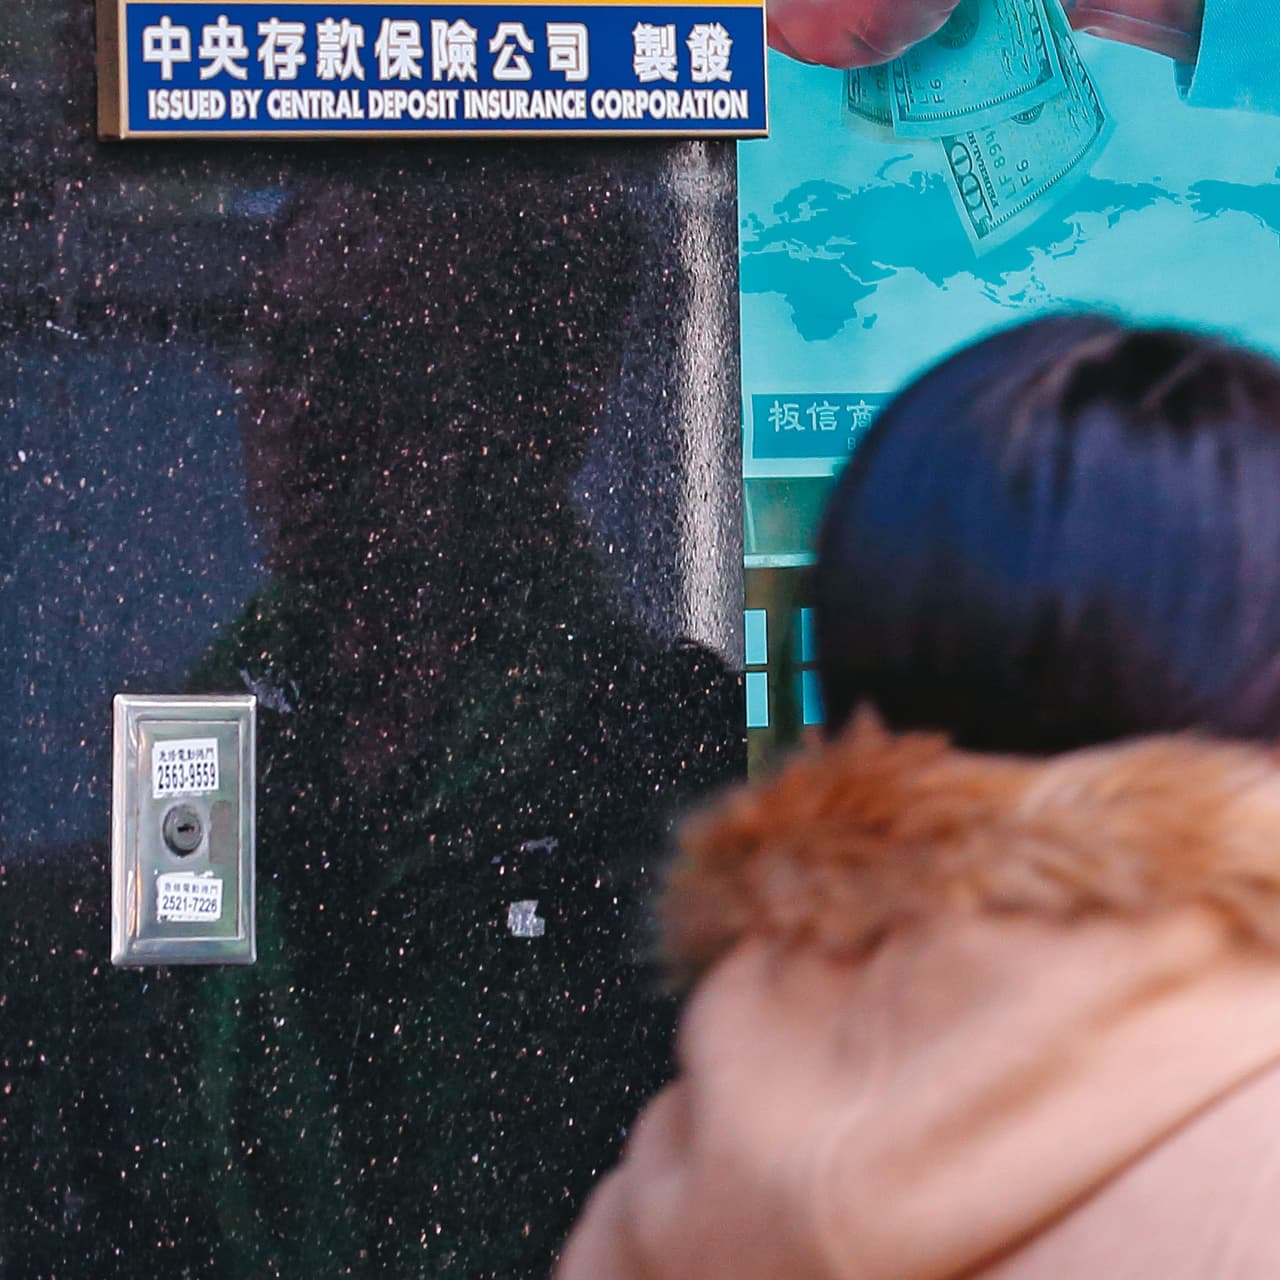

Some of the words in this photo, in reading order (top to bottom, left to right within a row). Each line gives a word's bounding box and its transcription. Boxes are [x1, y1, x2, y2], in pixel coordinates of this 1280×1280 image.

[142, 15, 589, 82] 中央存款保險公司
[632, 22, 734, 83] 製發
[148, 88, 226, 120] ISSUED
[231, 88, 263, 120] BY
[268, 88, 364, 120] CENTRAL
[368, 88, 458, 120] DEPOSIT
[464, 88, 587, 120] INSURANCE
[592, 88, 748, 121] CORPORATION
[157, 762, 216, 790] 2563-9559
